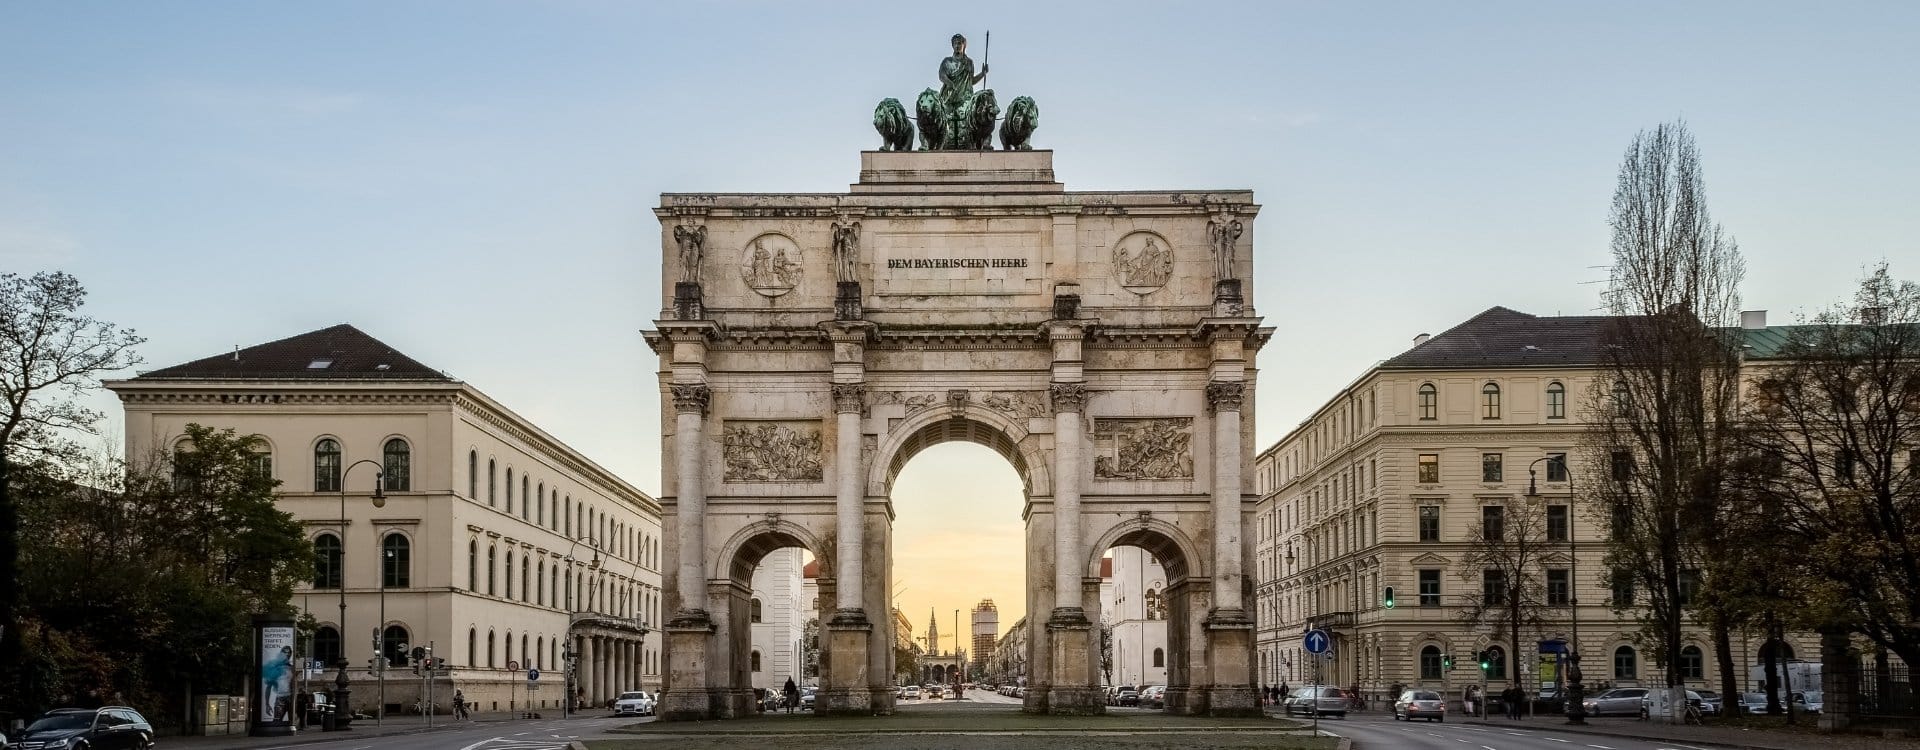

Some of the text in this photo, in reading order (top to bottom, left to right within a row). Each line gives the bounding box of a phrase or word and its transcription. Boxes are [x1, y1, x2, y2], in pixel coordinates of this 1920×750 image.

[888, 258, 1028, 269] DEM BAYERISCHEN HEERE
